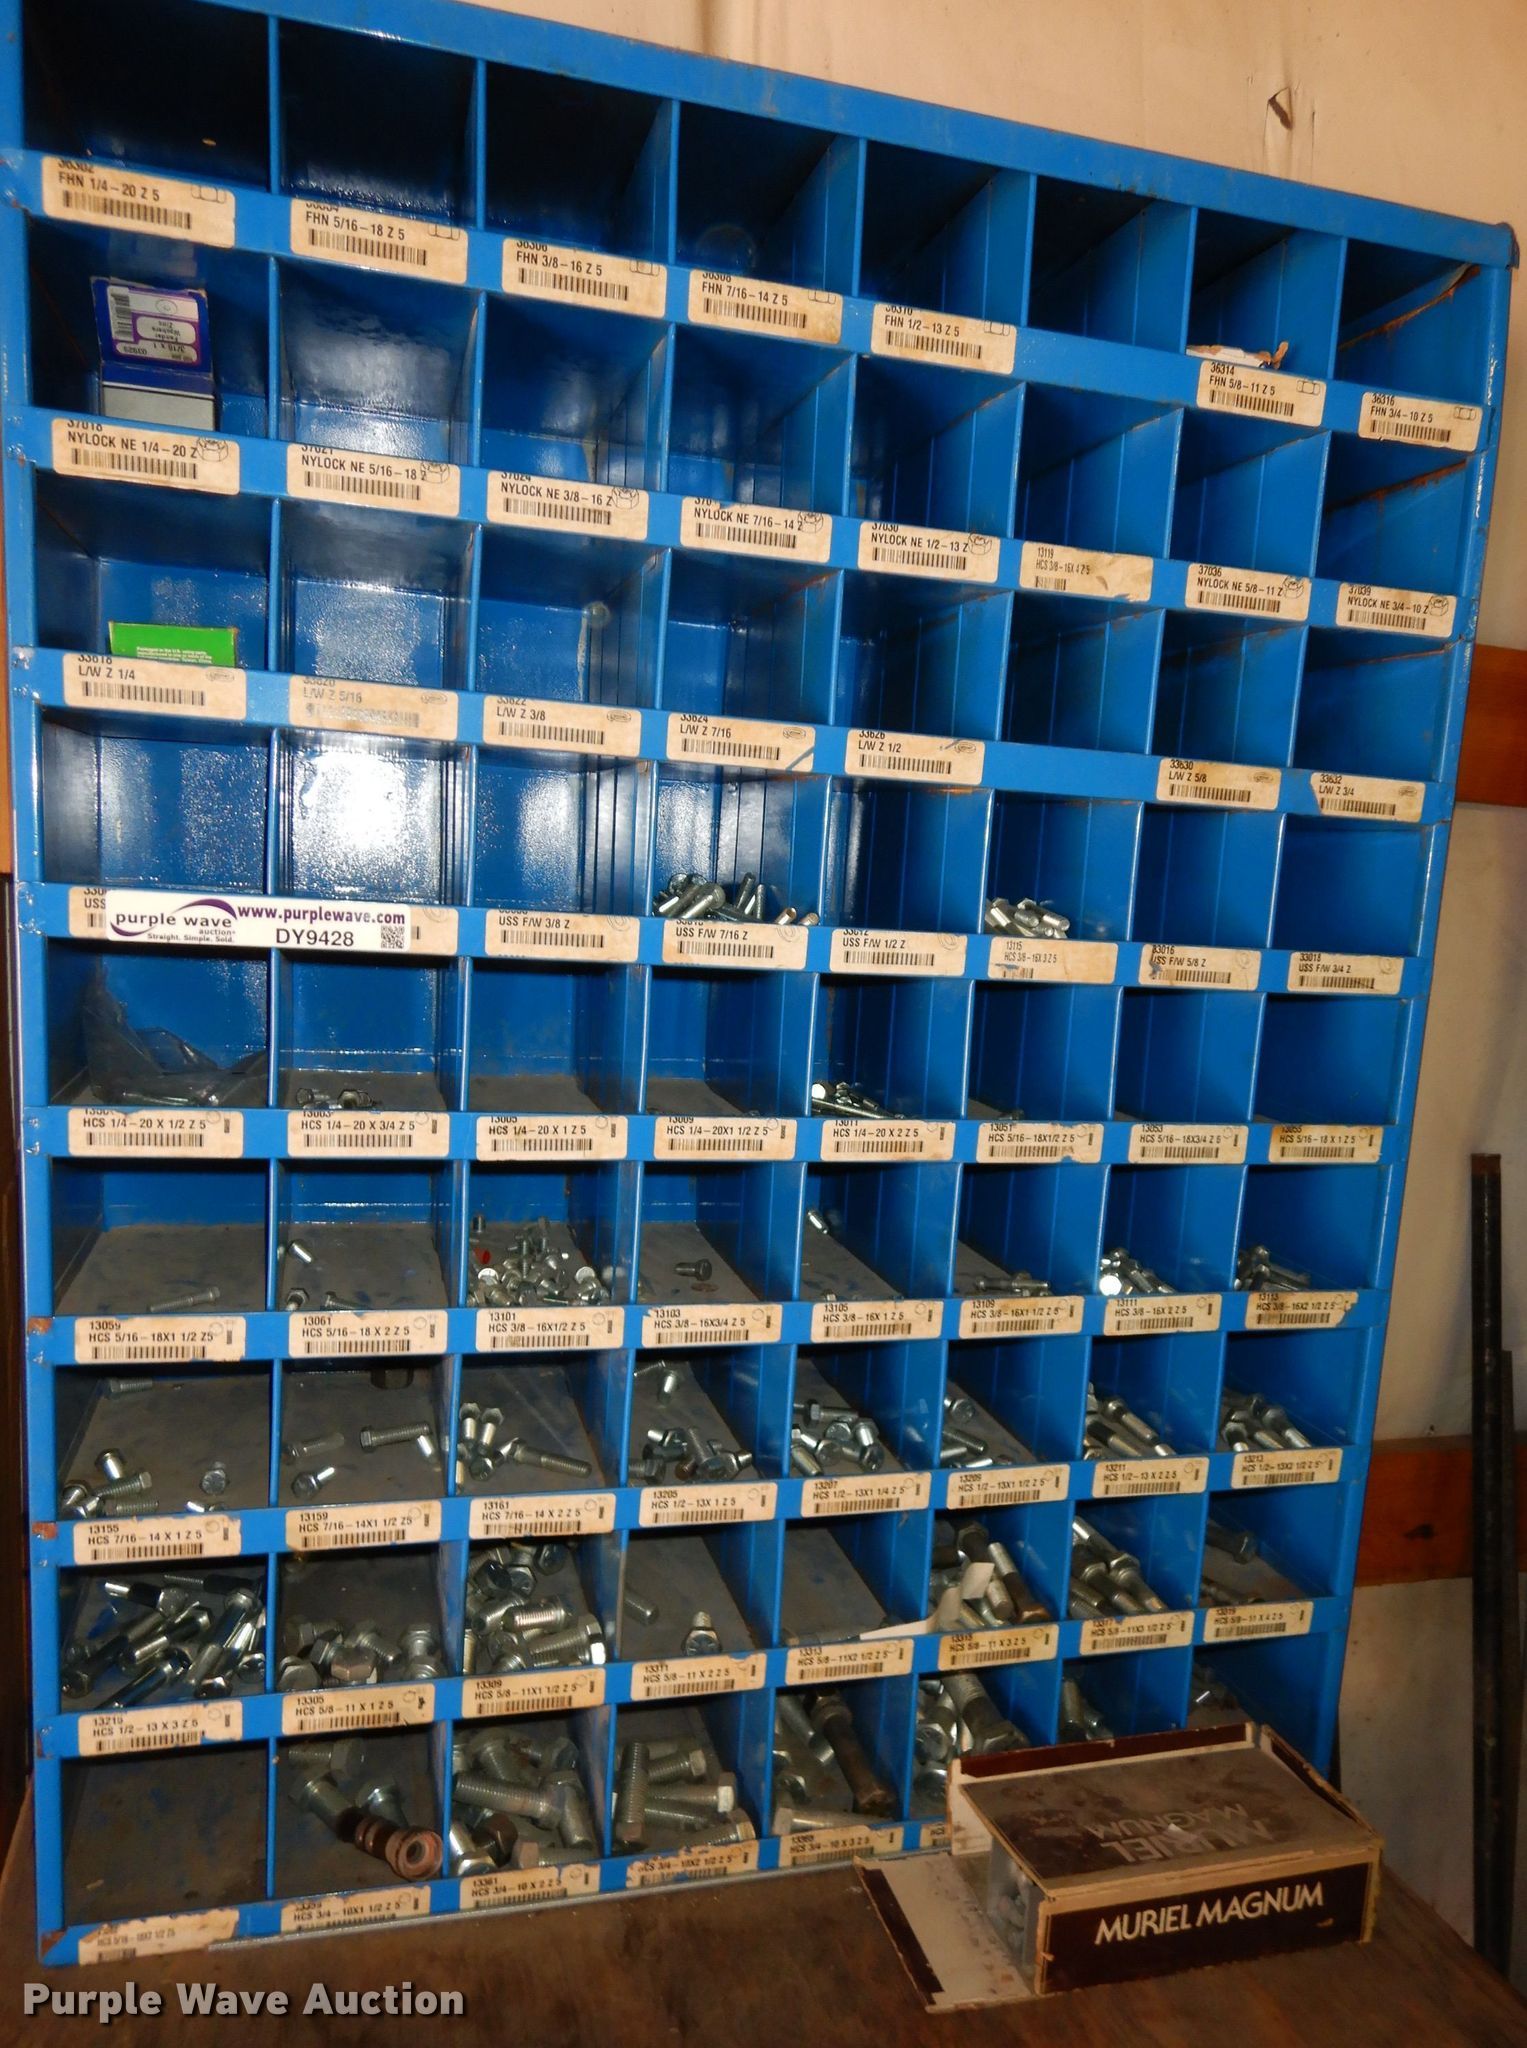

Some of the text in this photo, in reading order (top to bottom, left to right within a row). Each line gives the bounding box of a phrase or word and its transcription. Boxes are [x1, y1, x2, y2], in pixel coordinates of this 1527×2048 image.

[60, 171, 84, 187] FHN
[141, 186, 149, 199] Z
[153, 188, 161, 202] 5
[306, 210, 329, 226] FHN
[387, 226, 394, 239] Z
[398, 228, 404, 240] 5
[517, 250, 538, 265] FHN
[586, 262, 593, 274] Z
[596, 263, 602, 276] 5
[702, 282, 788, 306] FHN Z 5
[885, 316, 960, 337] FHN Z 5
[1209, 375, 1275, 396] FHN Z 5
[1370, 406, 1425, 422] FHN Z
[68, 430, 117, 448] NYLOCK
[121, 437, 137, 450] NE
[191, 446, 199, 458] Z
[302, 454, 345, 471] NYLOCK
[350, 460, 365, 473] NE
[501, 482, 542, 497] NYLOCK
[546, 487, 560, 500] NE
[606, 495, 612, 506] Z
[694, 507, 749, 524] NYLOCK NE
[871, 533, 968, 552] NYLOCK NE Z
[1198, 578, 1242, 591] NYLOCK NE
[1347, 596, 1390, 609] NYLOCK NE
[80, 666, 136, 680] L/W Z 1/4
[497, 708, 546, 722] L/W Z 3/8
[680, 724, 731, 739] L/W Z 7/16
[859, 740, 901, 753] L/W Z 1/2
[1168, 772, 1206, 783] L/W Z 5/8
[1319, 785, 1354, 796] L/W Z 3/4
[116, 913, 232, 928] purple wave
[238, 906, 405, 925] www.purplewave.com
[499, 916, 570, 930] USS F/W 3/8 Z
[276, 928, 354, 947] DY9428
[676, 927, 748, 940] USS F/W 7/16 Z
[843, 938, 906, 949] USS F/W 1/2 Z
[1169, 957, 1183, 966] F/W
[1186, 958, 1198, 967] 5/8
[1201, 959, 1205, 967] Z
[1298, 964, 1313, 972] USS
[84, 1118, 206, 1130] HCS X 1/2 Z 5
[301, 1120, 415, 1130] HCS X 3/4 Z 5
[489, 1125, 586, 1134] HCS X 1 Z 5
[667, 1126, 768, 1135] HCS 1/2 Z 5
[833, 1128, 918, 1137] HCS X 2 Z 5
[988, 1134, 1004, 1142] HCS
[1139, 1135, 1154, 1143] HCS
[1279, 1135, 1293, 1143] HCS
[823, 1313, 841, 1322] HCS
[971, 1309, 986, 1318] HCS
[489, 1323, 508, 1332] HCS
[654, 1320, 671, 1328] HCS
[89, 1333, 110, 1342] HCS
[302, 1328, 322, 1337] HCS
[482, 1511, 500, 1520] HCS
[299, 1523, 319, 1532] HCS
[88, 1535, 110, 1545] HCS
[296, 1706, 314, 1716] HCS
[93, 1726, 113, 1736] HCS
[1094, 1881, 1324, 1945] MURIEL MAGNUM
